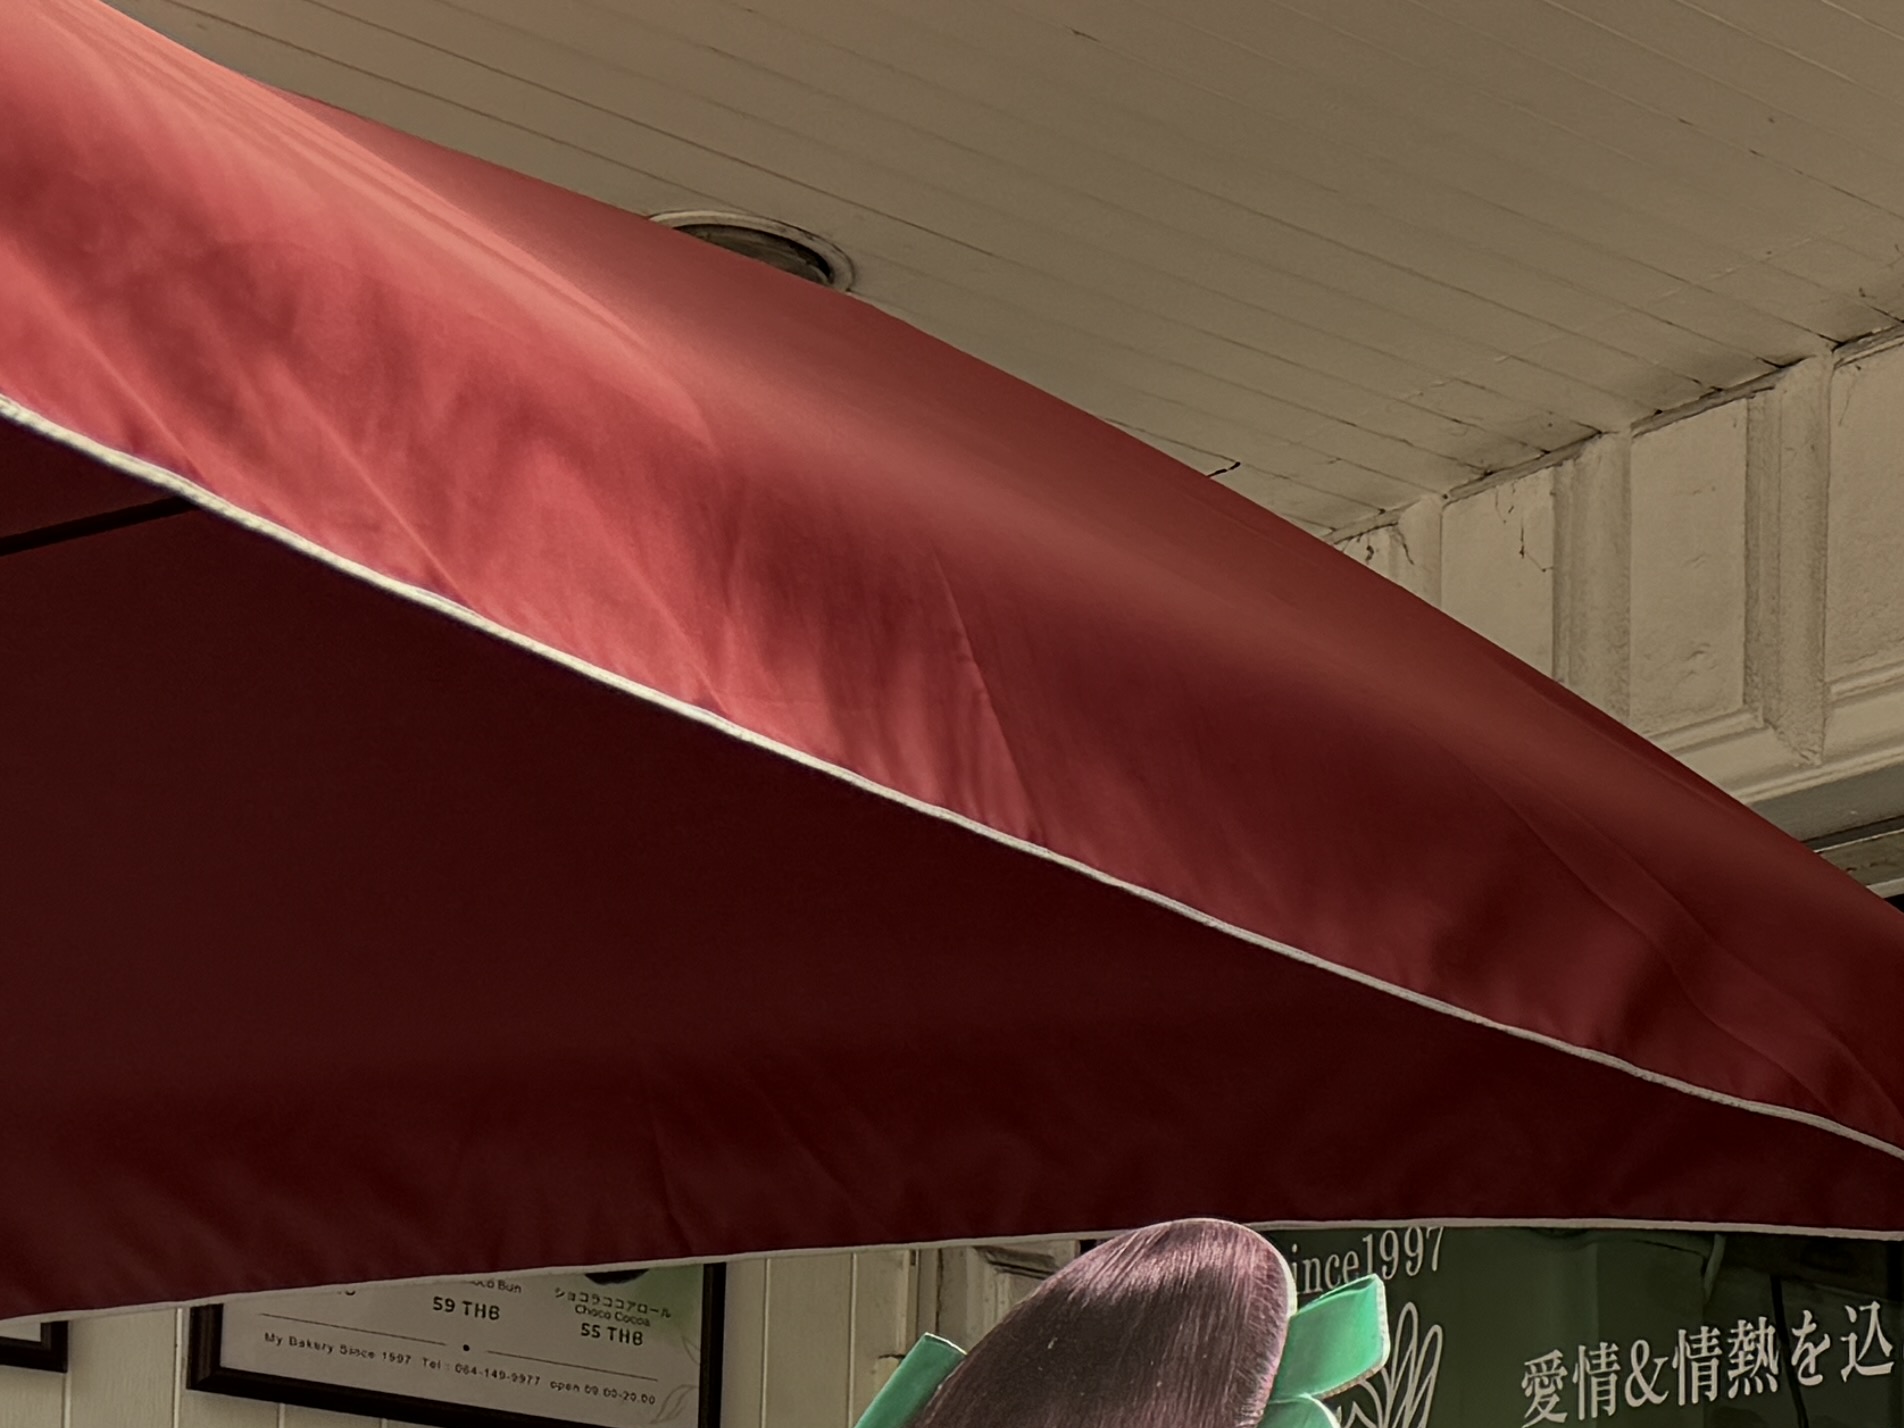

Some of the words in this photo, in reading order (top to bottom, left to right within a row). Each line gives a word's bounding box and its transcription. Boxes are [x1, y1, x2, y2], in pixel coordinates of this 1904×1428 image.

[1290, 1226, 1444, 1294] ince1997
[433, 1296, 455, 1312] 59
[462, 1300, 500, 1320] THB
[575, 1304, 611, 1320] Choco
[614, 1311, 650, 1327] Cocoa
[265, 1332, 282, 1346] My
[289, 1336, 333, 1354] Bakery
[581, 1323, 601, 1339] 55
[607, 1326, 643, 1345] THB
